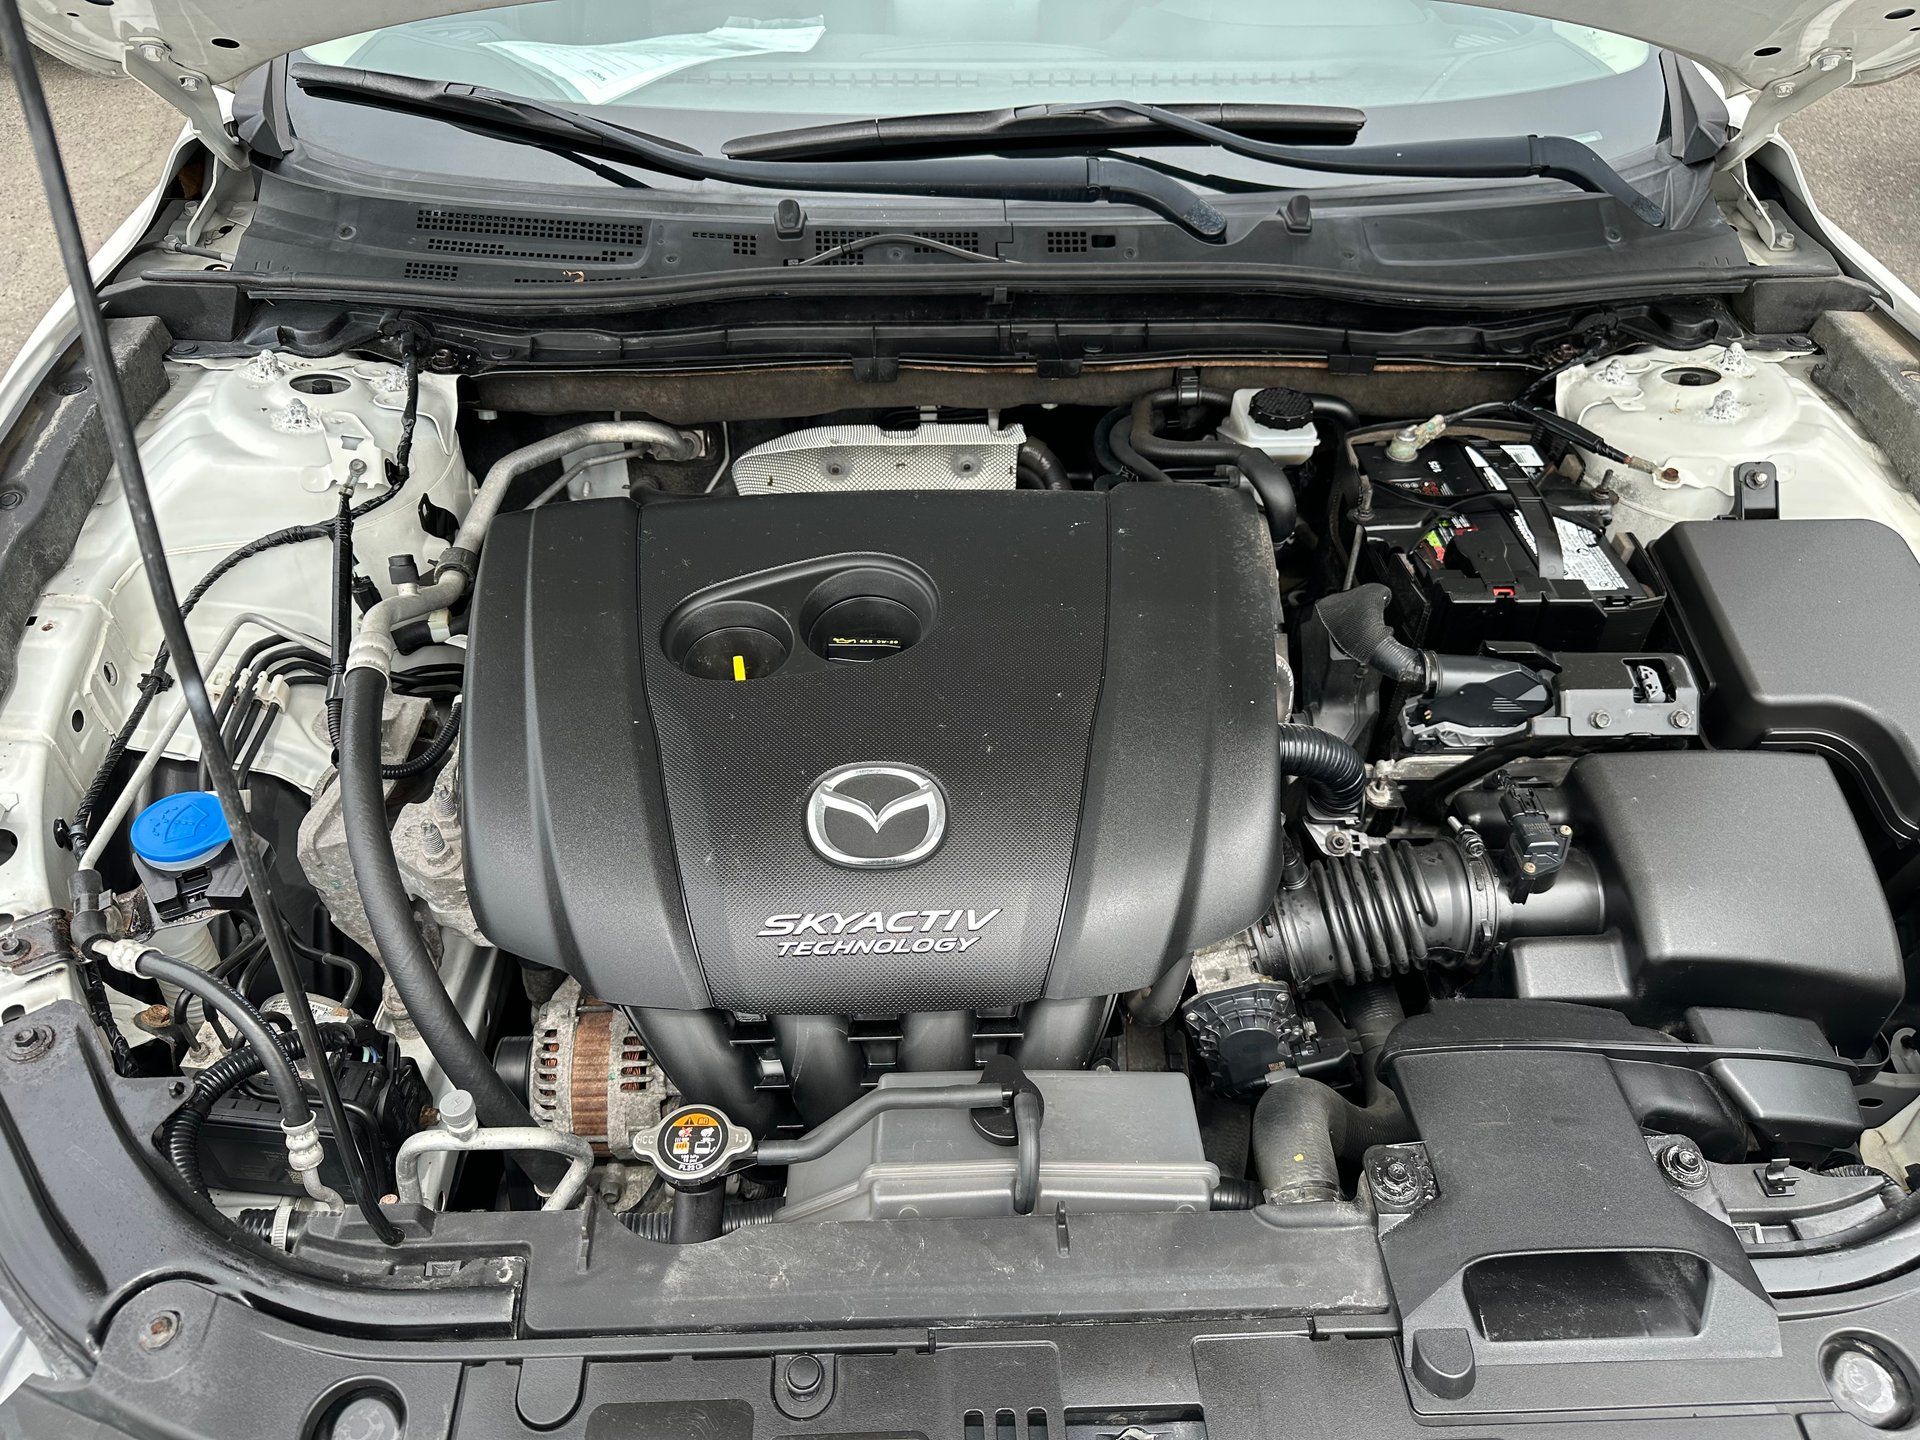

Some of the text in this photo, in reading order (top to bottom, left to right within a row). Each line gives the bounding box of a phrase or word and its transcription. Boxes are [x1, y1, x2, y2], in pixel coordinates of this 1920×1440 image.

[756, 908, 1003, 936] SKYACTIV
[777, 936, 981, 957] TECHNOLOGY
[636, 1135, 654, 1145] HCC
[735, 1134, 748, 1142] 1.1
